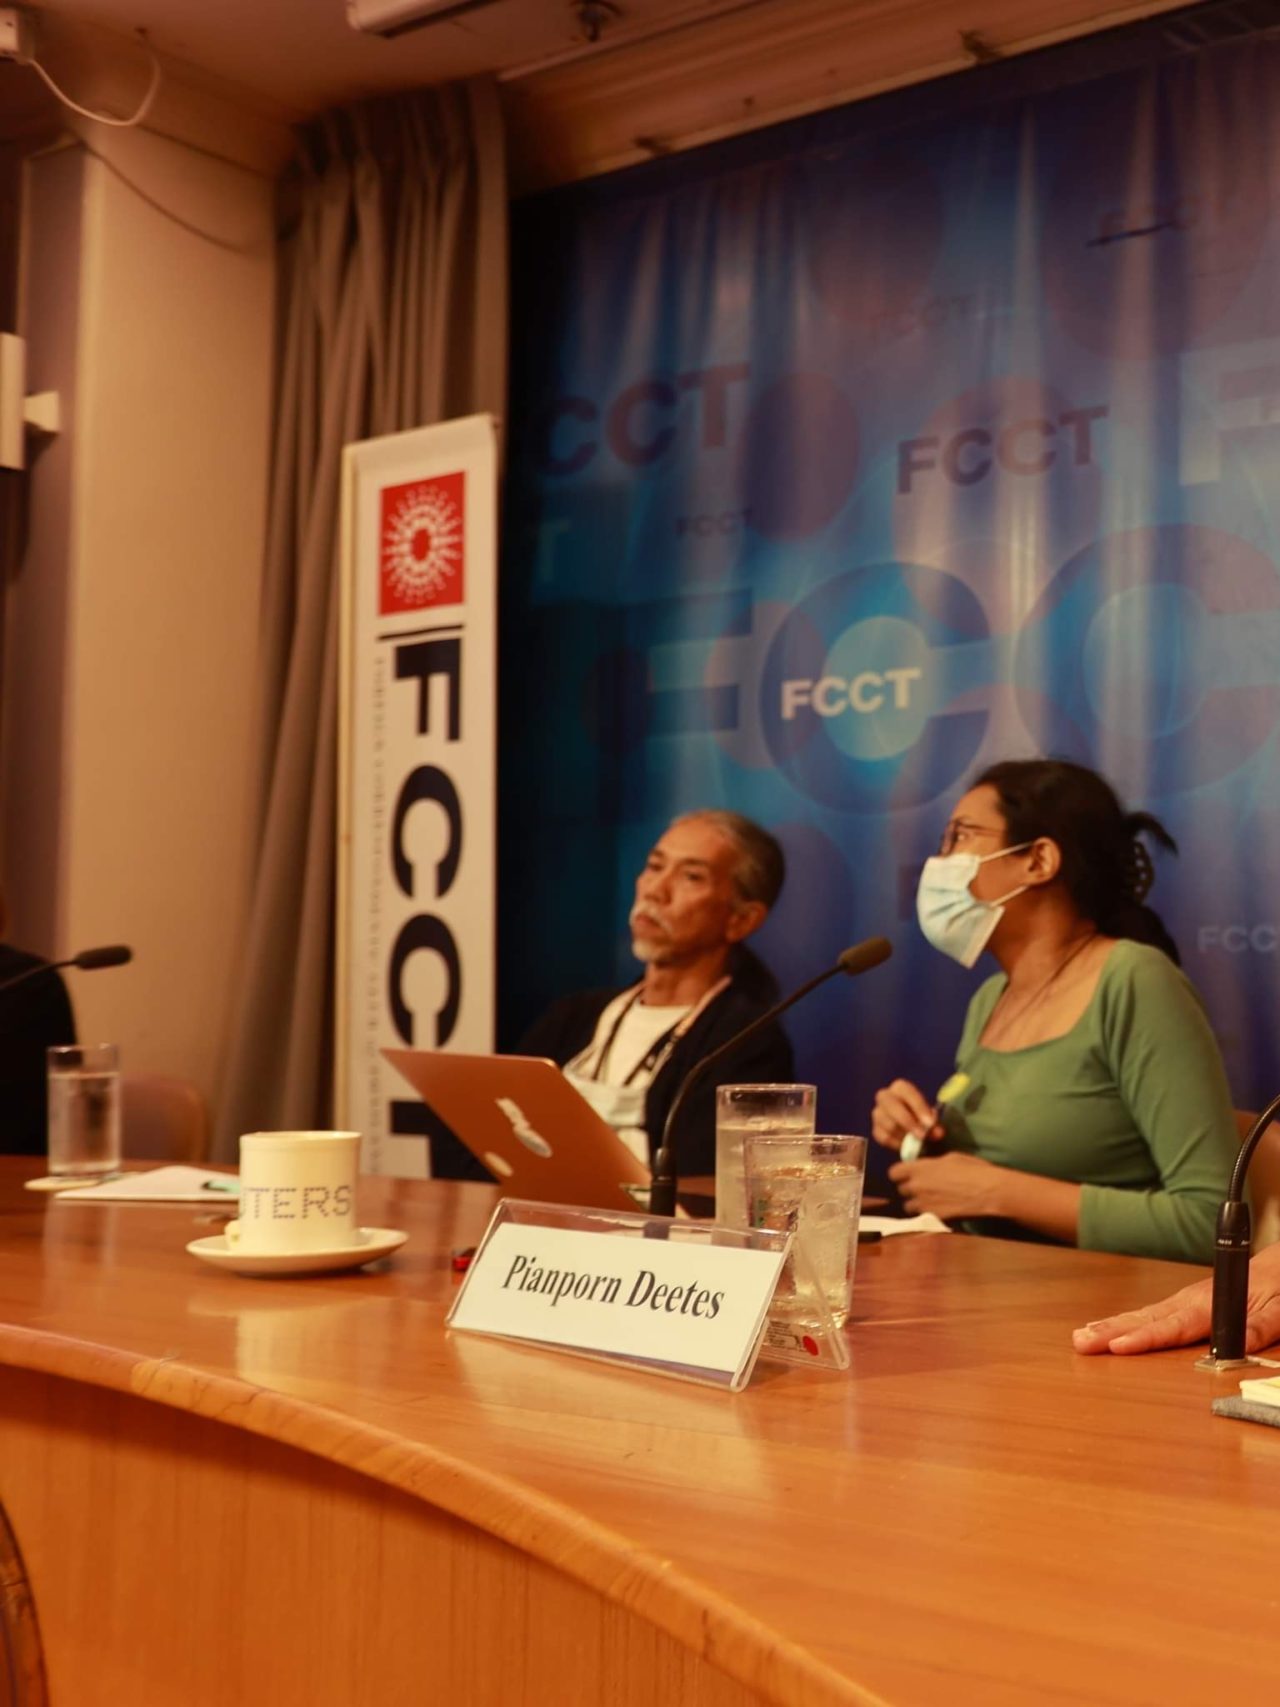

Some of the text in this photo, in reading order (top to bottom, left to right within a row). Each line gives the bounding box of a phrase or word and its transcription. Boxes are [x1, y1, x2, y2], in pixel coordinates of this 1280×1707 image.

[896, 405, 1109, 495] FCCT
[780, 667, 923, 721] FCCT
[502, 1254, 725, 1320] Pianporn Deetes
